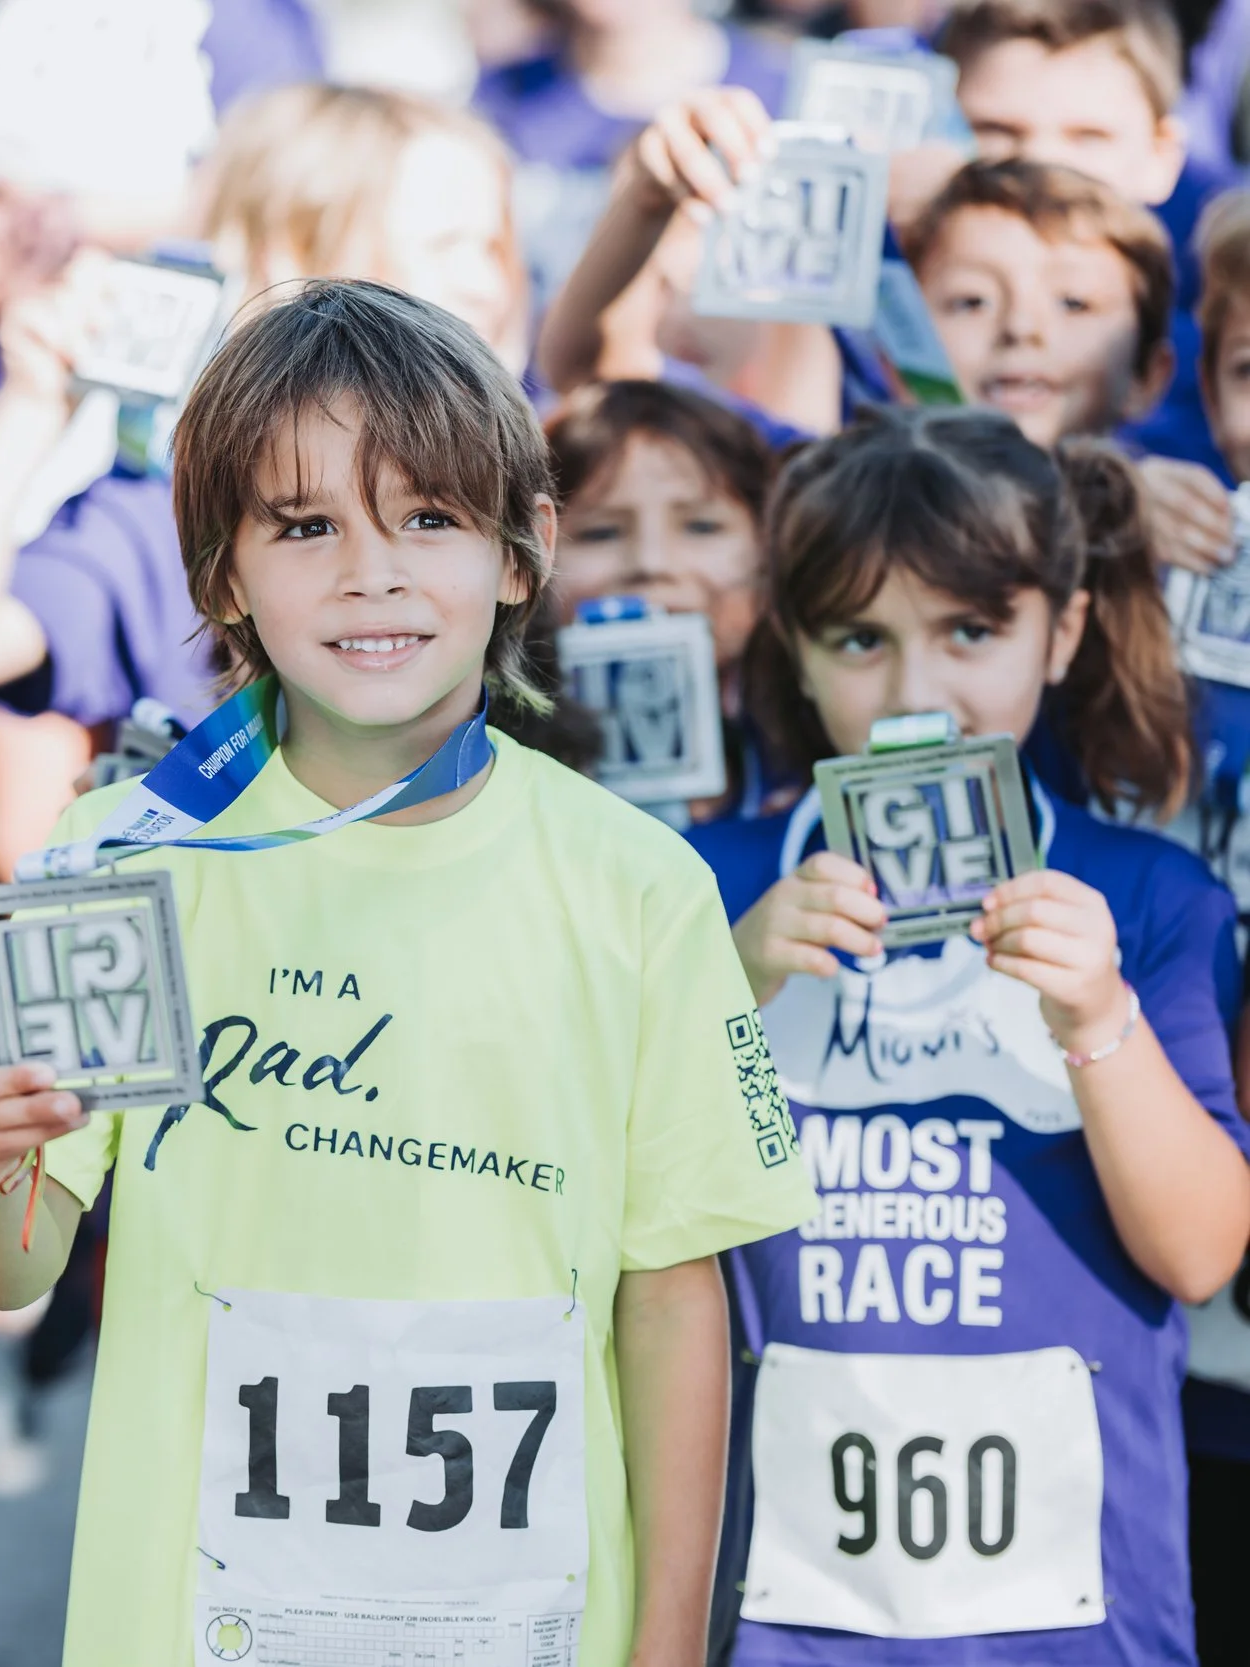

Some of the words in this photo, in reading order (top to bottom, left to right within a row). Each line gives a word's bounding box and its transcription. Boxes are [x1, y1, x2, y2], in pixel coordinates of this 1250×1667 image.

[198, 741, 238, 780] CHAMPION
[230, 724, 250, 753] FOR
[269, 967, 324, 997] I'M
[336, 972, 361, 1001] A
[143, 1013, 394, 1172] Rad.
[284, 1122, 566, 1196] CHANGEMAKER
[800, 1113, 1005, 1194] MOST
[798, 1243, 1005, 1327] RACE
[234, 1375, 558, 1533] 1157
[830, 1431, 1017, 1561] 960
[208, 1605, 221, 1613] DO
[221, 1606, 238, 1614] NOT
[238, 1607, 252, 1615] PIN
[284, 1607, 313, 1616] PLEASE
[315, 1610, 338, 1618] PRINT
[344, 1612, 360, 1620] USE
[361, 1613, 405, 1623] BALLPOINT
[406, 1614, 419, 1622] OR
[419, 1615, 459, 1623] INDELIBLE
[461, 1615, 475, 1623] INK
